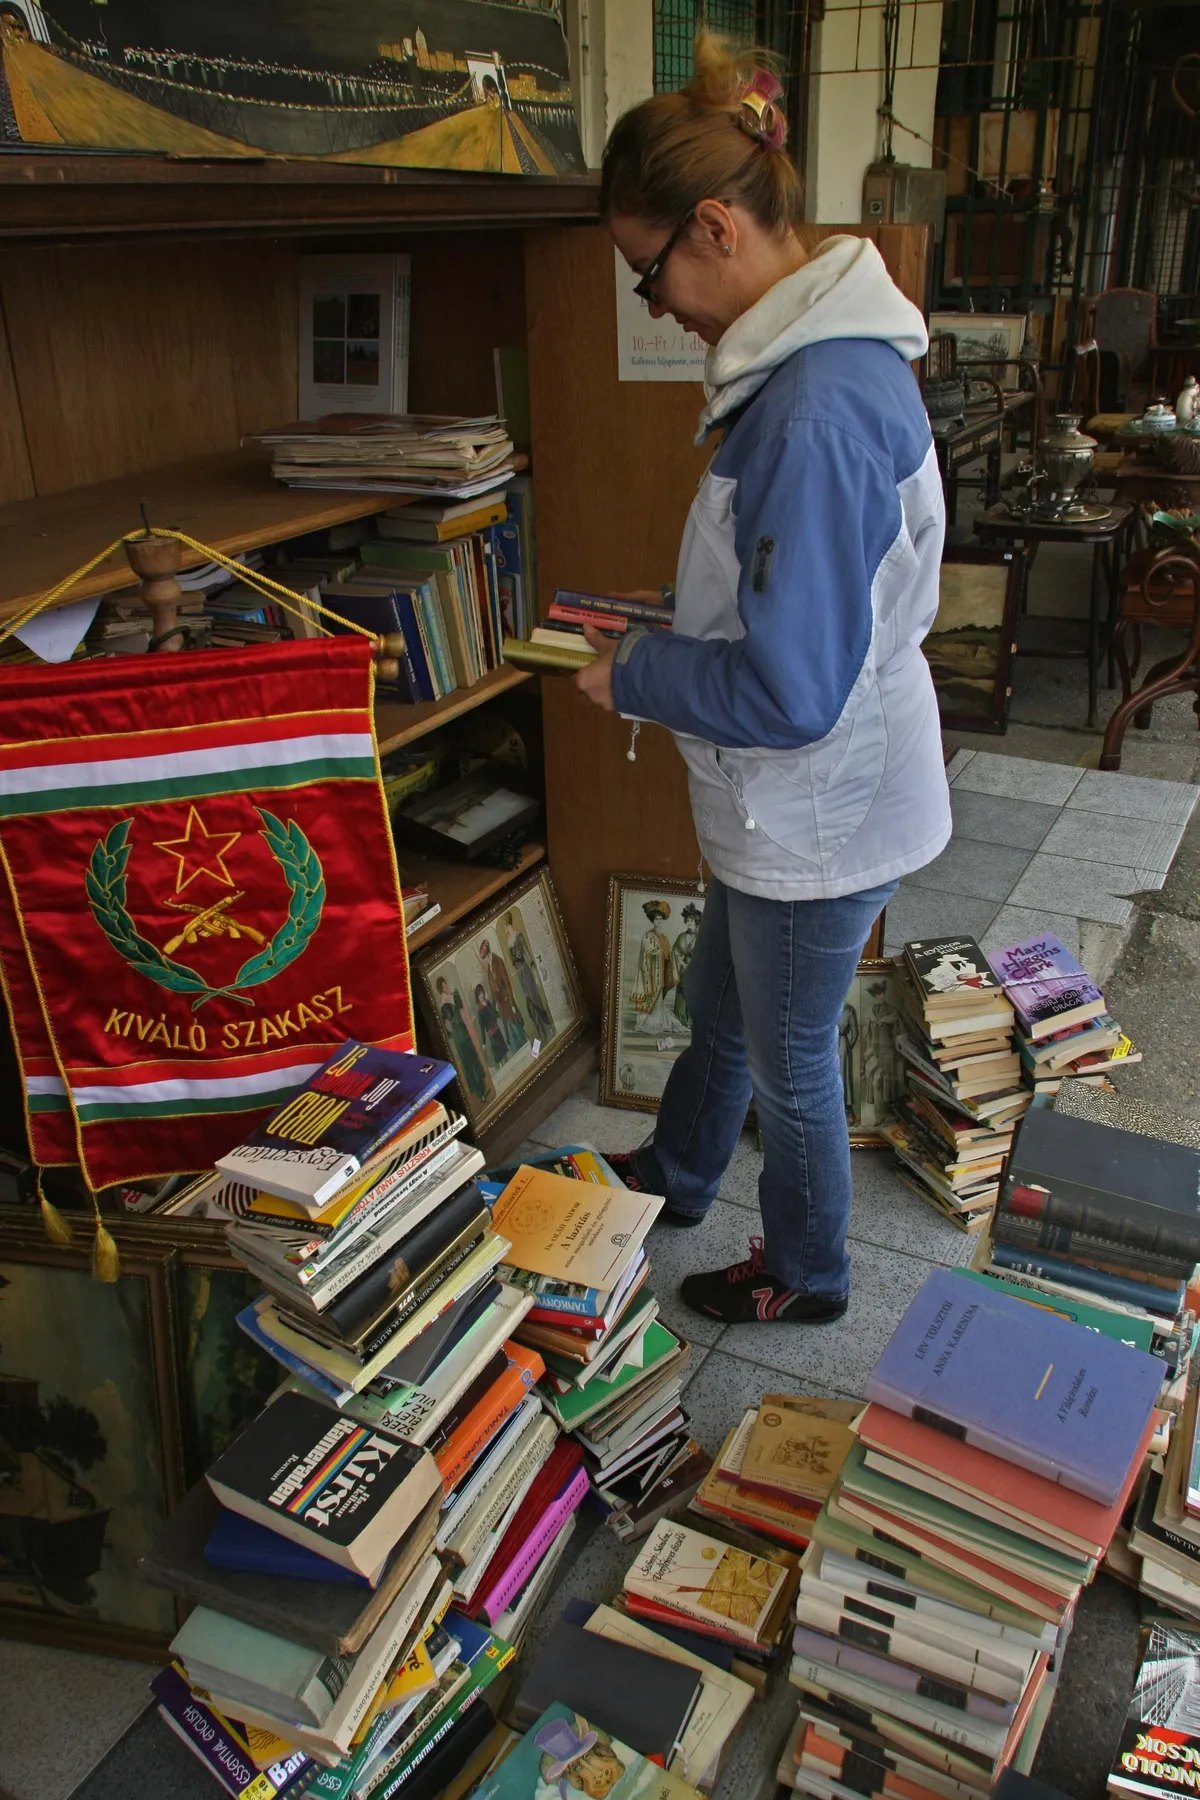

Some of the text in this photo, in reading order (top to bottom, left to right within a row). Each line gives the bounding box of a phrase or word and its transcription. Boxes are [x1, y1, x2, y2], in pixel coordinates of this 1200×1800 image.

[1001, 945, 1061, 974] Higgins
[1006, 941, 1046, 961] Mary
[1011, 961, 1055, 980] Clark
[104, 986, 353, 1052] KIVÁLÓ SZAKASZ
[325, 1045, 368, 1078] 97
[361, 1078, 400, 1111] for
[266, 1091, 351, 1146] WORD
[445, 1119, 464, 1135] salgó
[430, 1132, 449, 1149] jános
[232, 1144, 342, 1172] Egyszerűen
[395, 1145, 431, 1177] KRISZTUS
[374, 1175, 396, 1195] TANÚI
[406, 1171, 423, 1187] nagy
[368, 1192, 376, 1200] A
[548, 1222, 567, 1242] OLÁH
[561, 1200, 582, 1223] ANDOR
[559, 1209, 591, 1251] A lazítás
[335, 1265, 357, 1284] EMBER
[355, 1257, 366, 1267] AZ
[326, 1282, 338, 1293] FIA
[396, 1291, 416, 1311] 1975
[535, 1294, 588, 1313] TANKÖNYV
[914, 1339, 931, 1360] LEV
[931, 1302, 979, 1376] ANNA KARENINA
[411, 1404, 430, 1416] AZ
[1076, 1385, 1100, 1417] Remekei
[380, 1415, 415, 1437] SZER
[1055, 1413, 1066, 1423] A
[461, 1402, 509, 1465] TANULJUNK
[524, 1432, 545, 1459] GÁBOR
[267, 1417, 359, 1507] Kameraden
[270, 1454, 299, 1482] Roman
[304, 1432, 403, 1528] Kirst
[504, 1467, 531, 1502] HOGYAN
[335, 1484, 368, 1519] Hellmut
[348, 1491, 371, 1514] Hans
[408, 1741, 434, 1768] PENTRU
[430, 1717, 455, 1743] TESTUL
[457, 1684, 484, 1713] TOEFL
[183, 1704, 251, 1784] ESSENTIAL ENGLISH
[267, 1751, 307, 1787] Barr
[258, 1779, 269, 1792] 18
